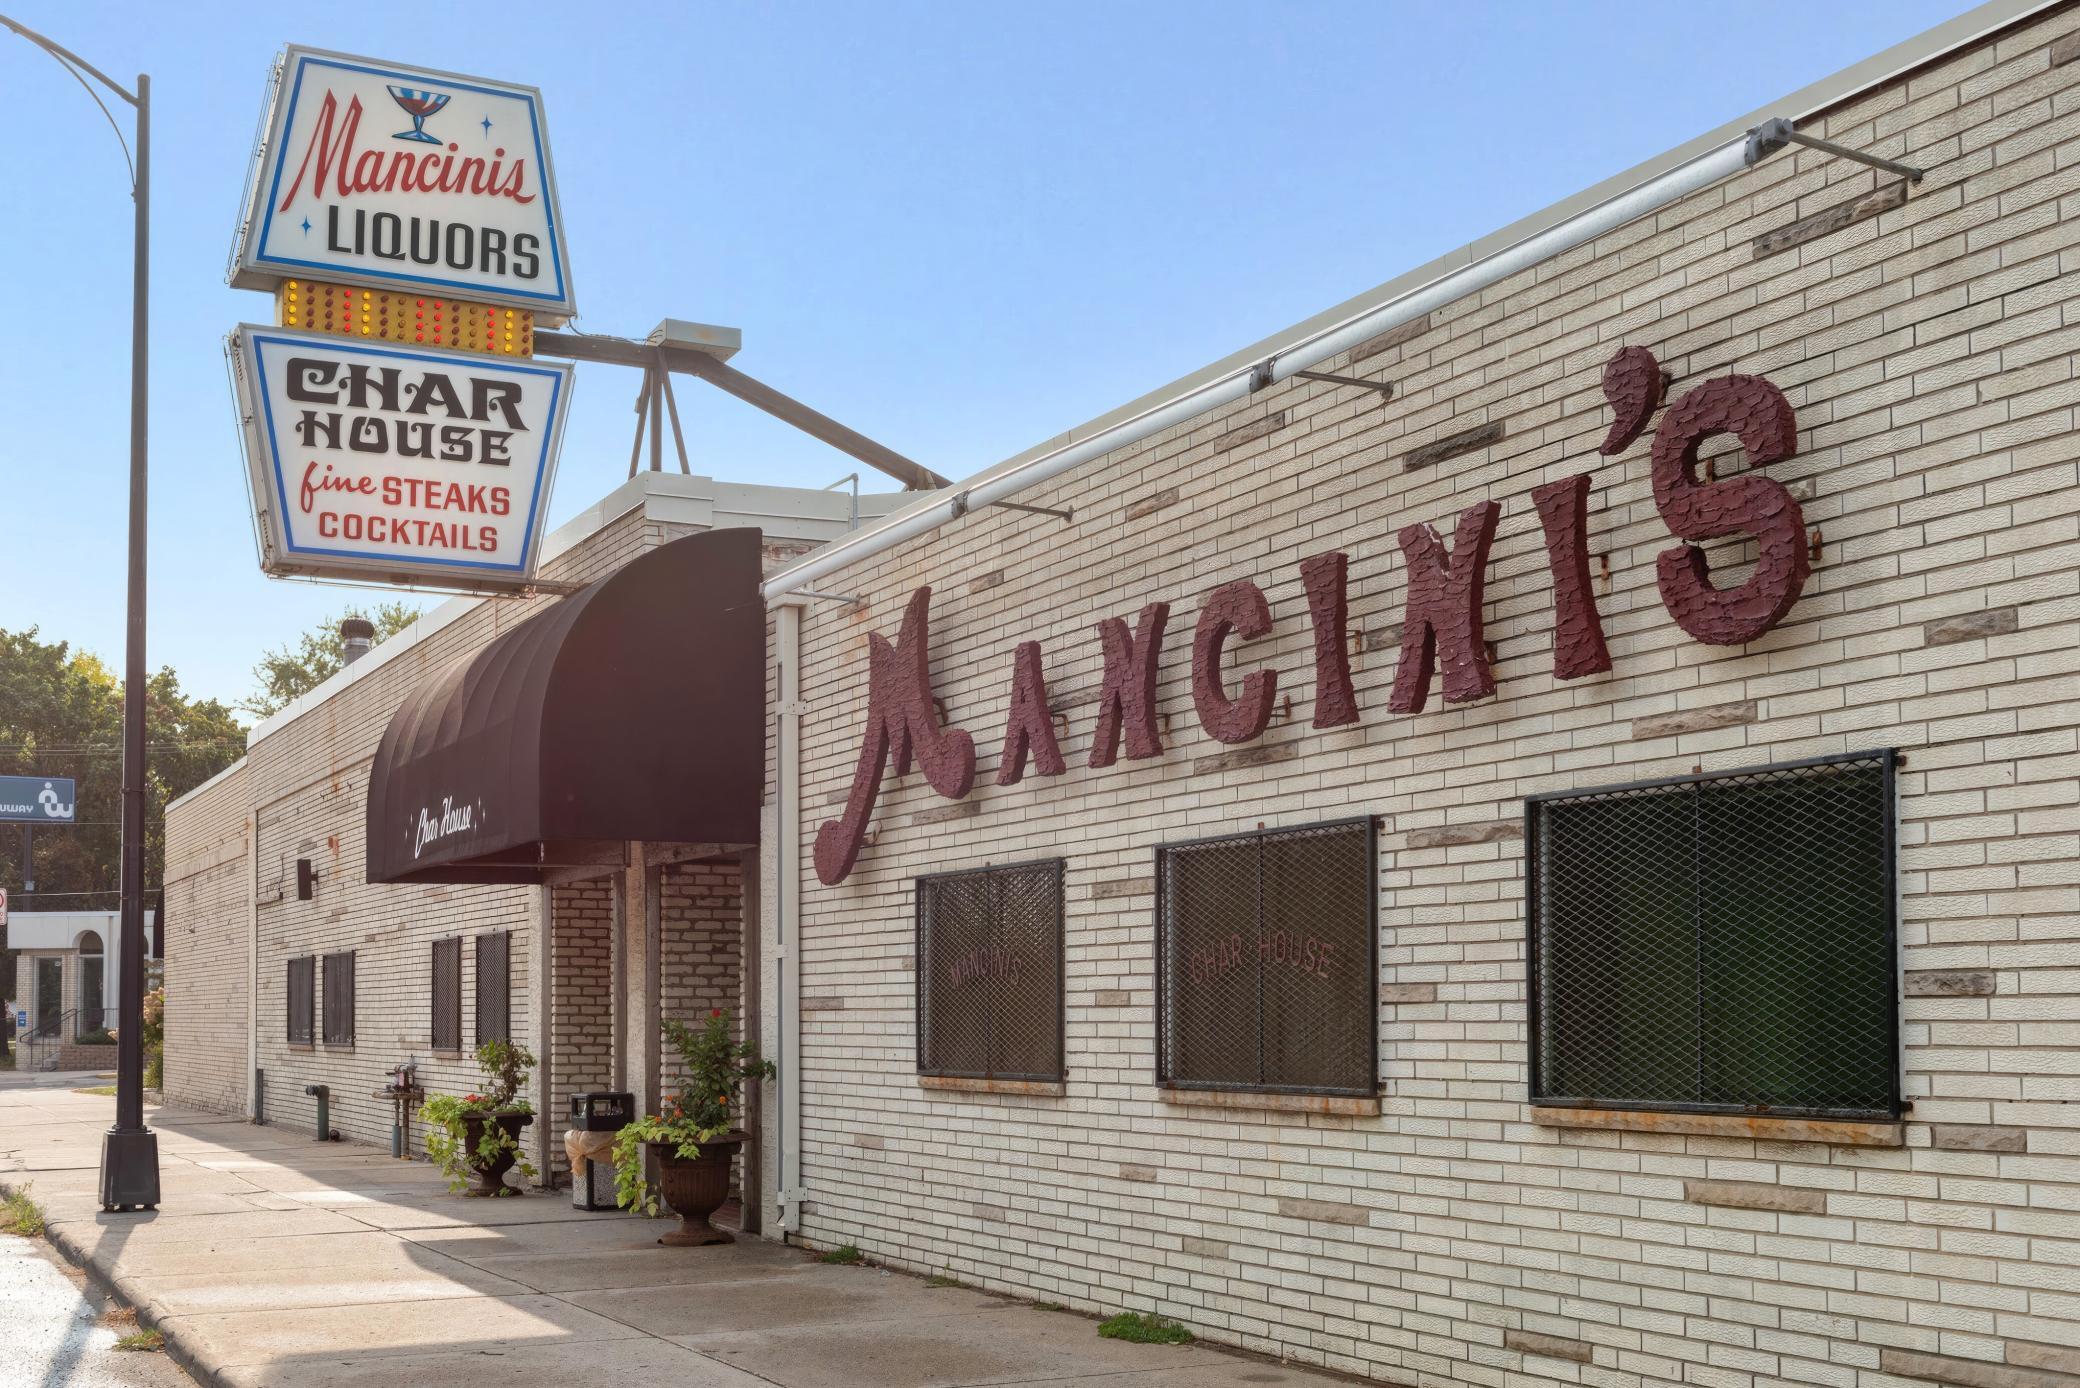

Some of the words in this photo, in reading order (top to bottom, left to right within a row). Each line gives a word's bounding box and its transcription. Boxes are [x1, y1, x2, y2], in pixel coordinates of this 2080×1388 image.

[279, 87, 536, 213] Mancinis
[328, 205, 540, 279] LIQUORS
[286, 357, 530, 431] CHAR
[295, 410, 515, 466] HOUSE
[300, 460, 377, 514] fine
[382, 475, 510, 516] STEAKS
[319, 511, 498, 552] COCKTAILS
[813, 345, 1811, 886] MANCINI'S
[414, 807, 439, 859] Char
[440, 796, 472, 837] House
[1191, 933, 1243, 985] CHAR
[1259, 928, 1335, 979] HOUSE
